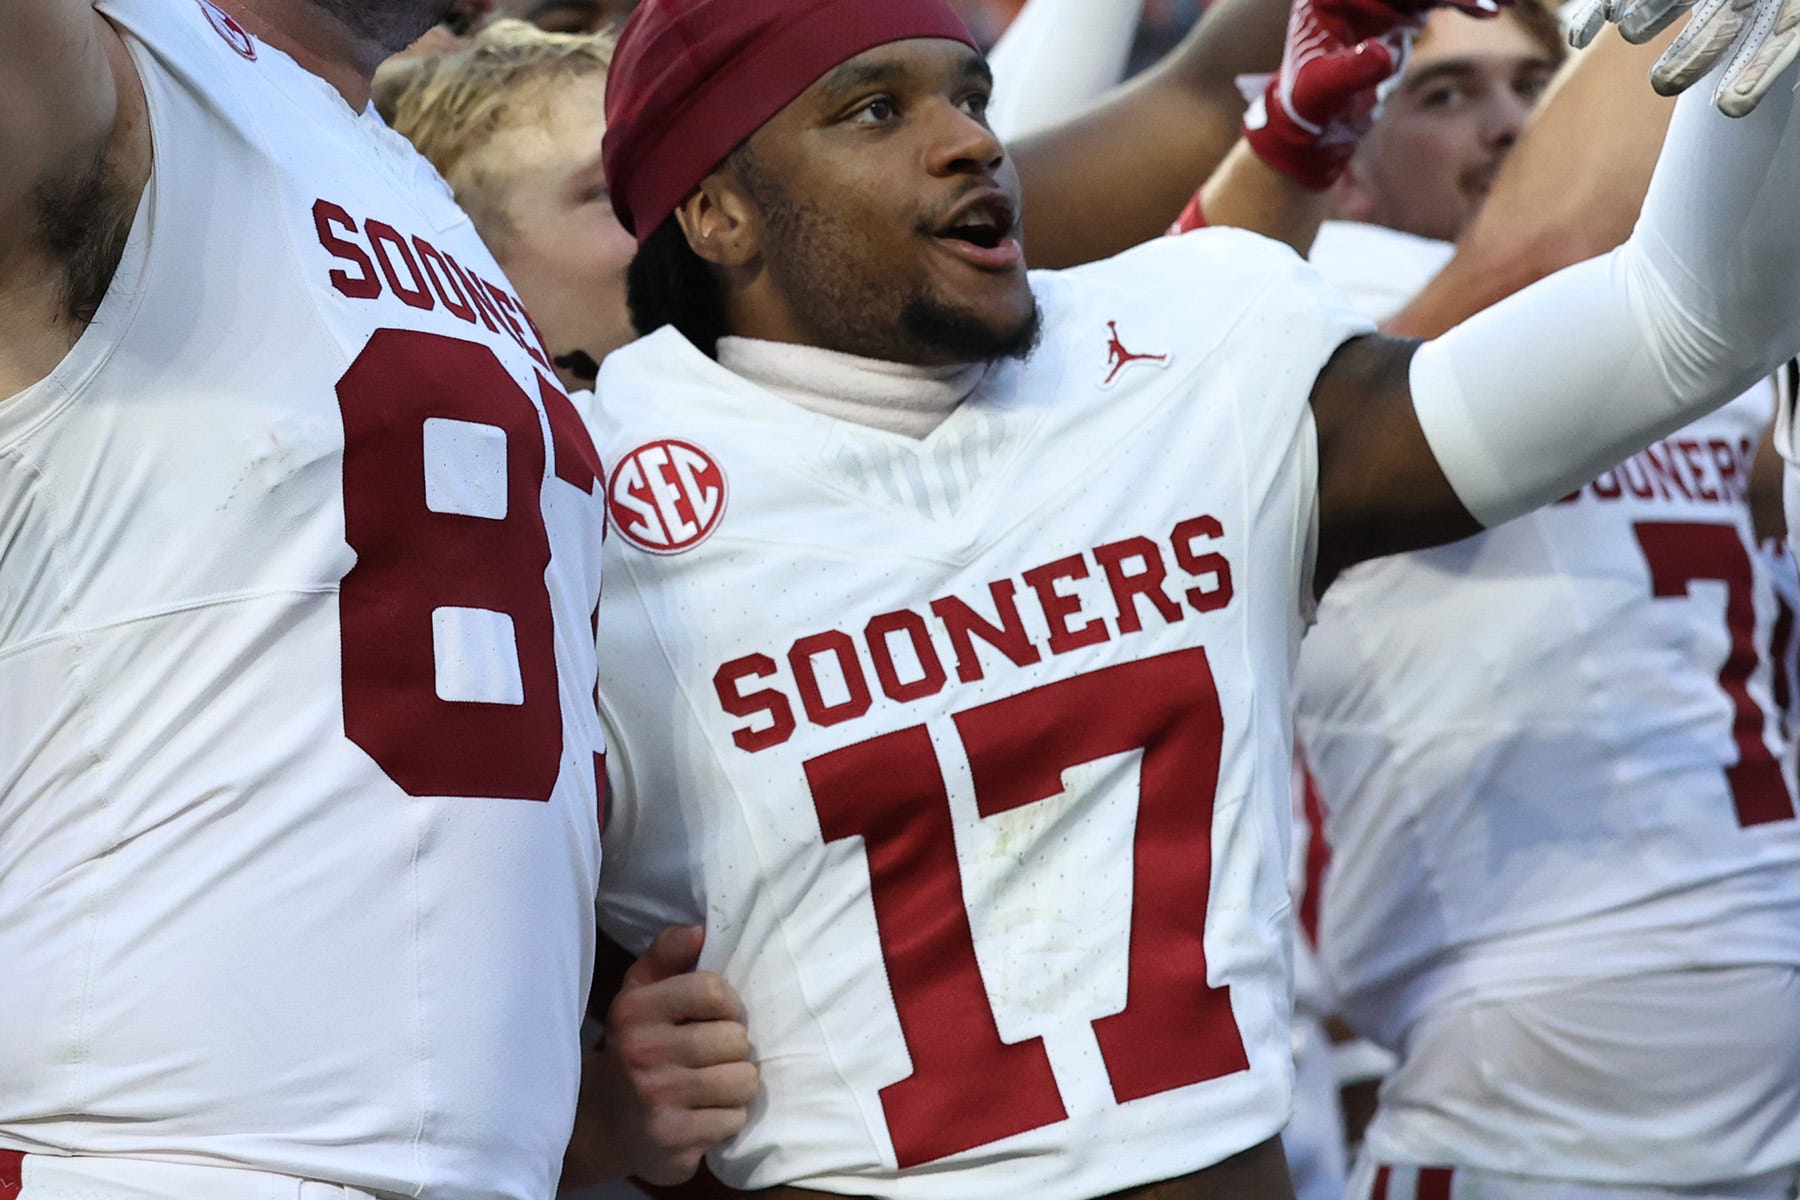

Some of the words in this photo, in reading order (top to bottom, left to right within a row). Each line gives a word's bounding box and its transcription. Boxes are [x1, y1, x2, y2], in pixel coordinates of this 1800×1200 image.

[612, 443, 720, 548] SEC
[713, 514, 1234, 754] SOONERS
[802, 645, 1251, 1169] 17
